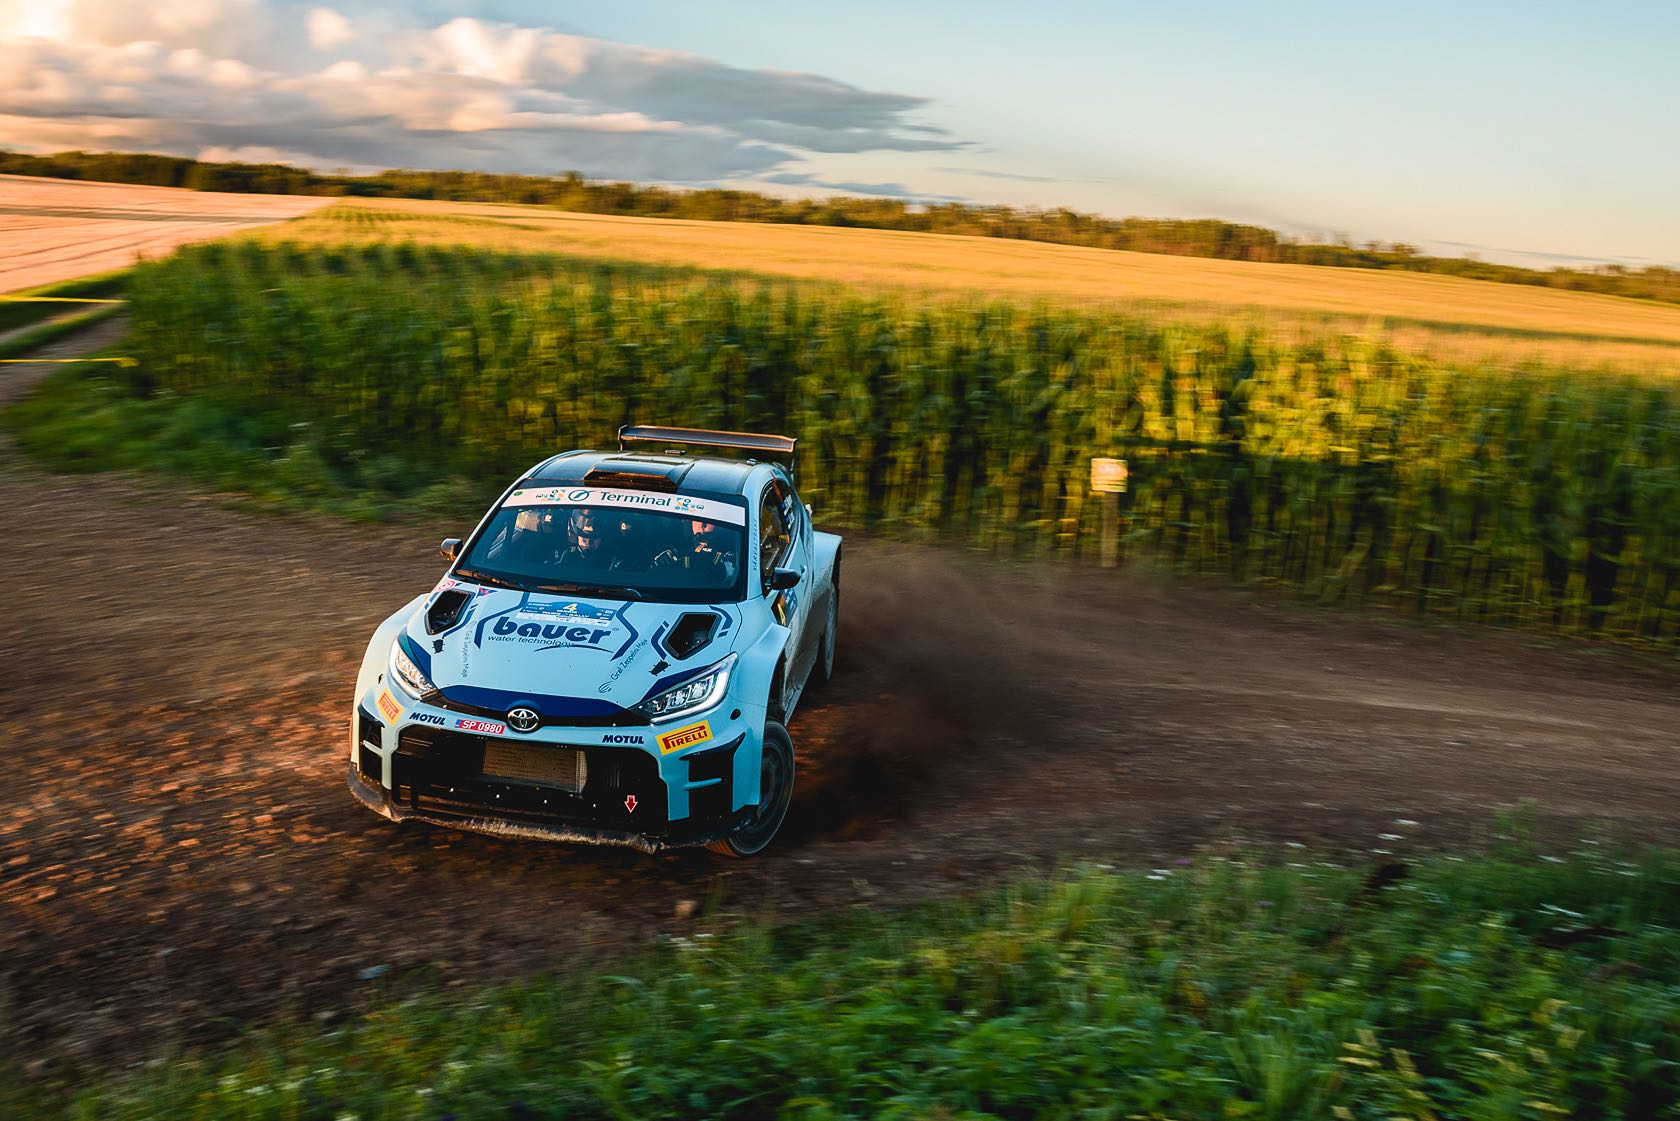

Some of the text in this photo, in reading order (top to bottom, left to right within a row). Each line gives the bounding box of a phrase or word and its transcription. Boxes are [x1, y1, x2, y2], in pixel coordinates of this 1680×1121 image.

[600, 491, 671, 507] Terminal
[562, 603, 578, 611] 4
[493, 616, 611, 644] bauer
[518, 636, 575, 648] technology
[379, 692, 399, 720] PIRELLI
[409, 712, 447, 725] MOTUL
[462, 720, 503, 733] SP 0980
[602, 735, 644, 744] MOTUL
[662, 725, 708, 750] PIRELLI
